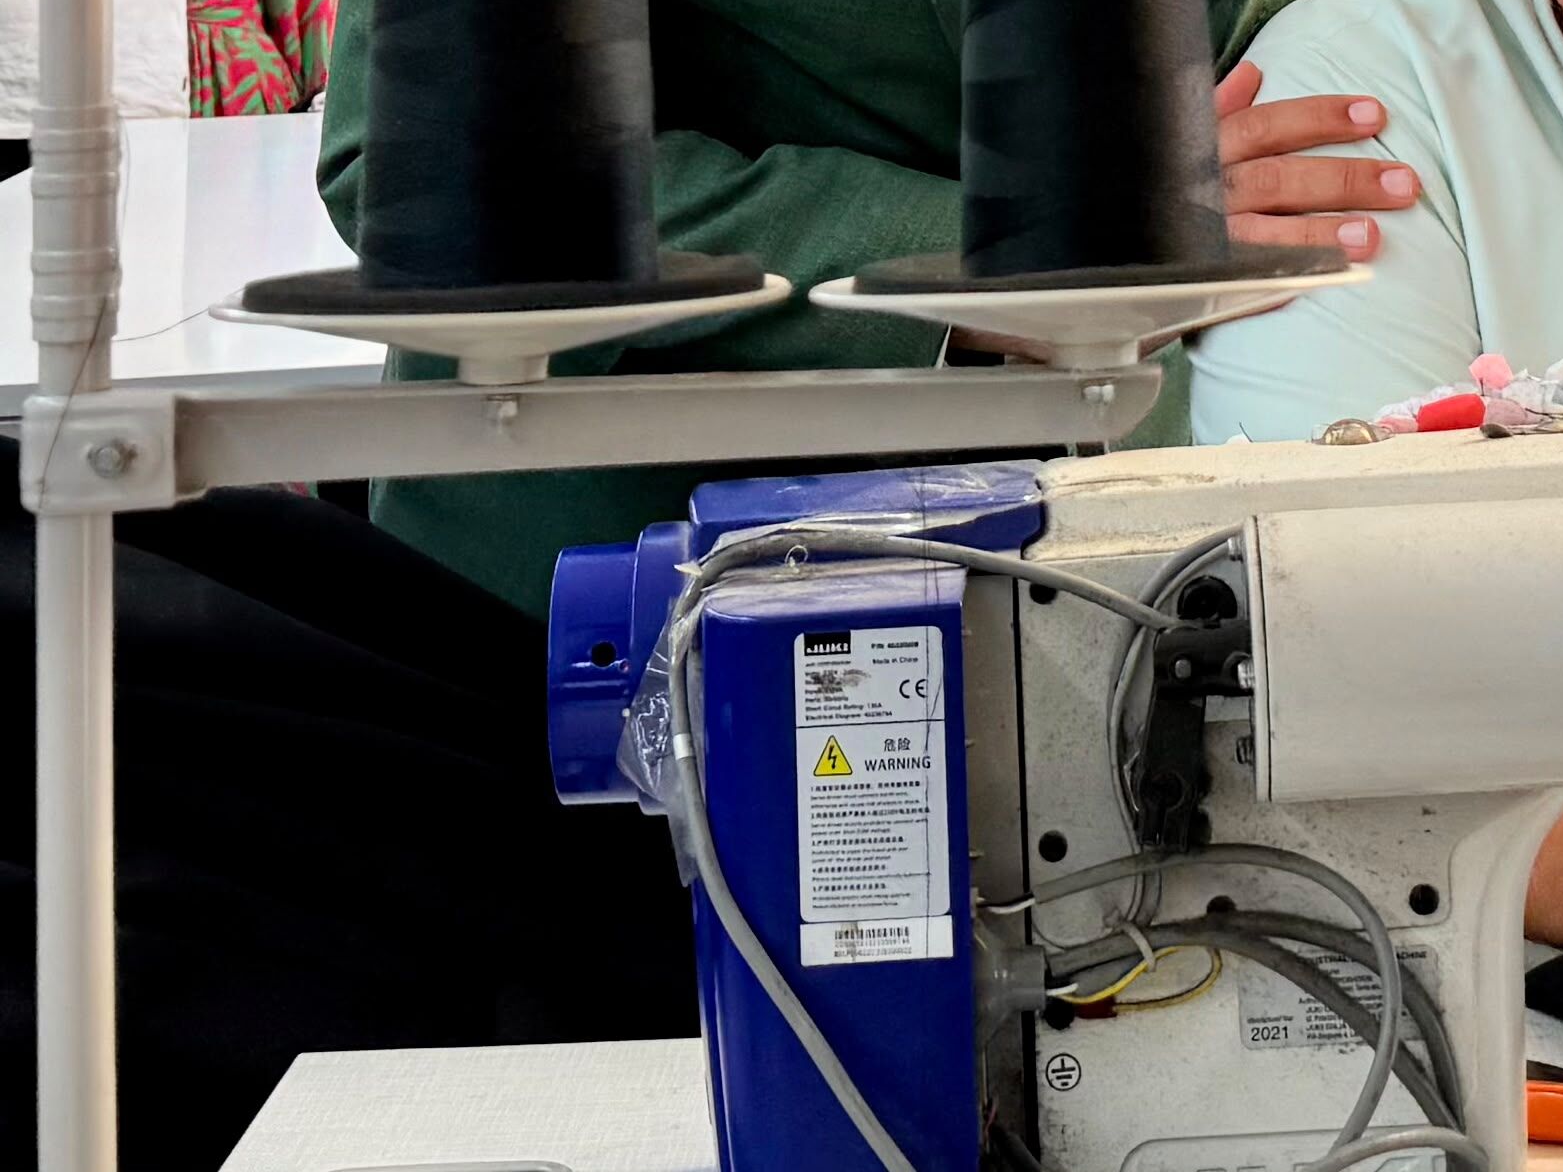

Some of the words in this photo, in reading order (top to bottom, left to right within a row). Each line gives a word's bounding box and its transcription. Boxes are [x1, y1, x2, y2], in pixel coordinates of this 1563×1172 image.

[884, 737, 911, 752] 危险
[864, 756, 931, 772] WARNING
[1250, 1025, 1290, 1042] 2021
